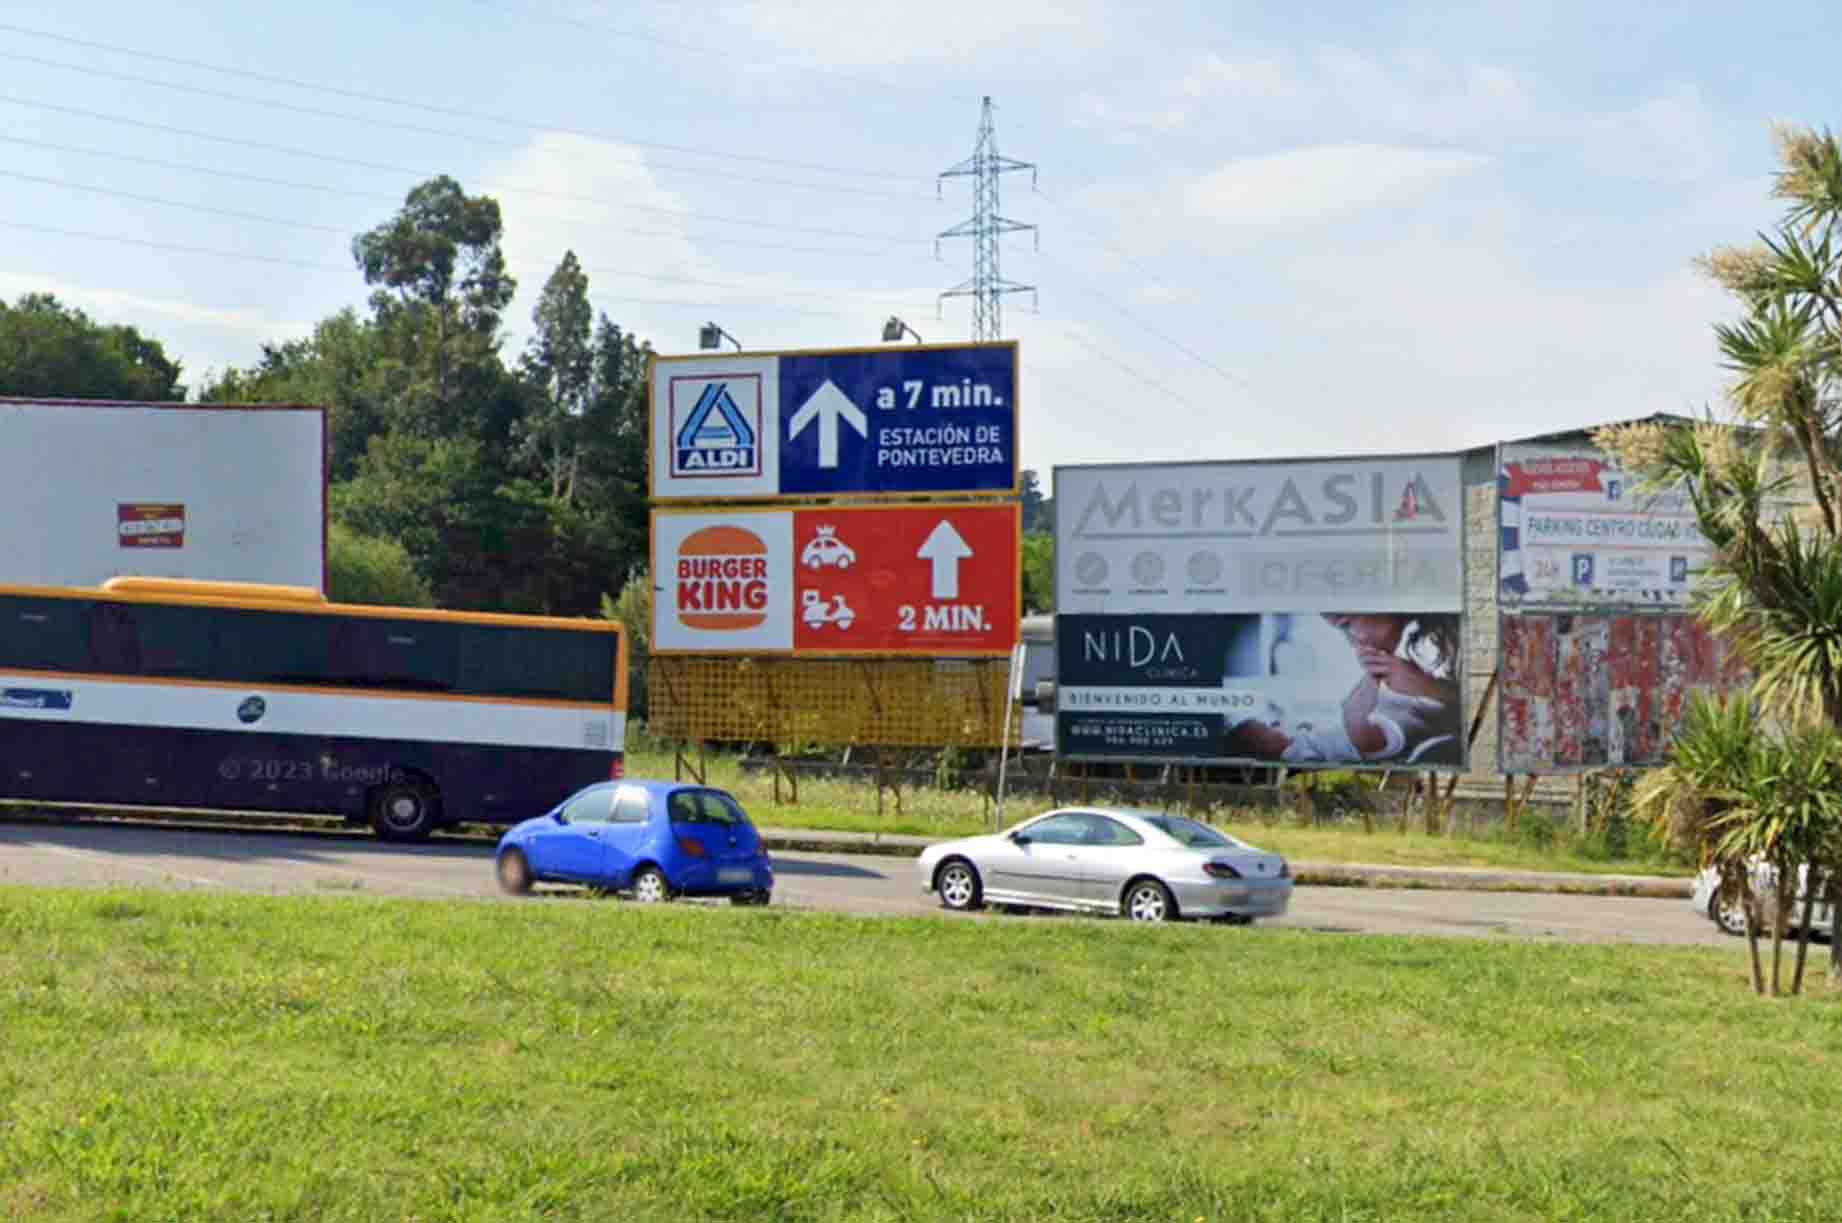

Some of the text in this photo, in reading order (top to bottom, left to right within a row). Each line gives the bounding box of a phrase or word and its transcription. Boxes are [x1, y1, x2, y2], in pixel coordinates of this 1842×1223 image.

[876, 378, 1003, 409] a 7 min.
[879, 424, 1001, 446] ESTACIÓN DE
[684, 450, 748, 469] ALDI
[877, 447, 1004, 467] PONTEVEDRA
[1527, 517, 1584, 538] PARKING
[1586, 519, 1633, 538] CENTRO
[677, 558, 768, 580] BURGER
[677, 580, 768, 611] KING
[898, 605, 993, 632] 2 MIN.
[1084, 625, 1185, 668] NIDA
[1069, 692, 1256, 707] BIENVENIDO AL MUNDO
